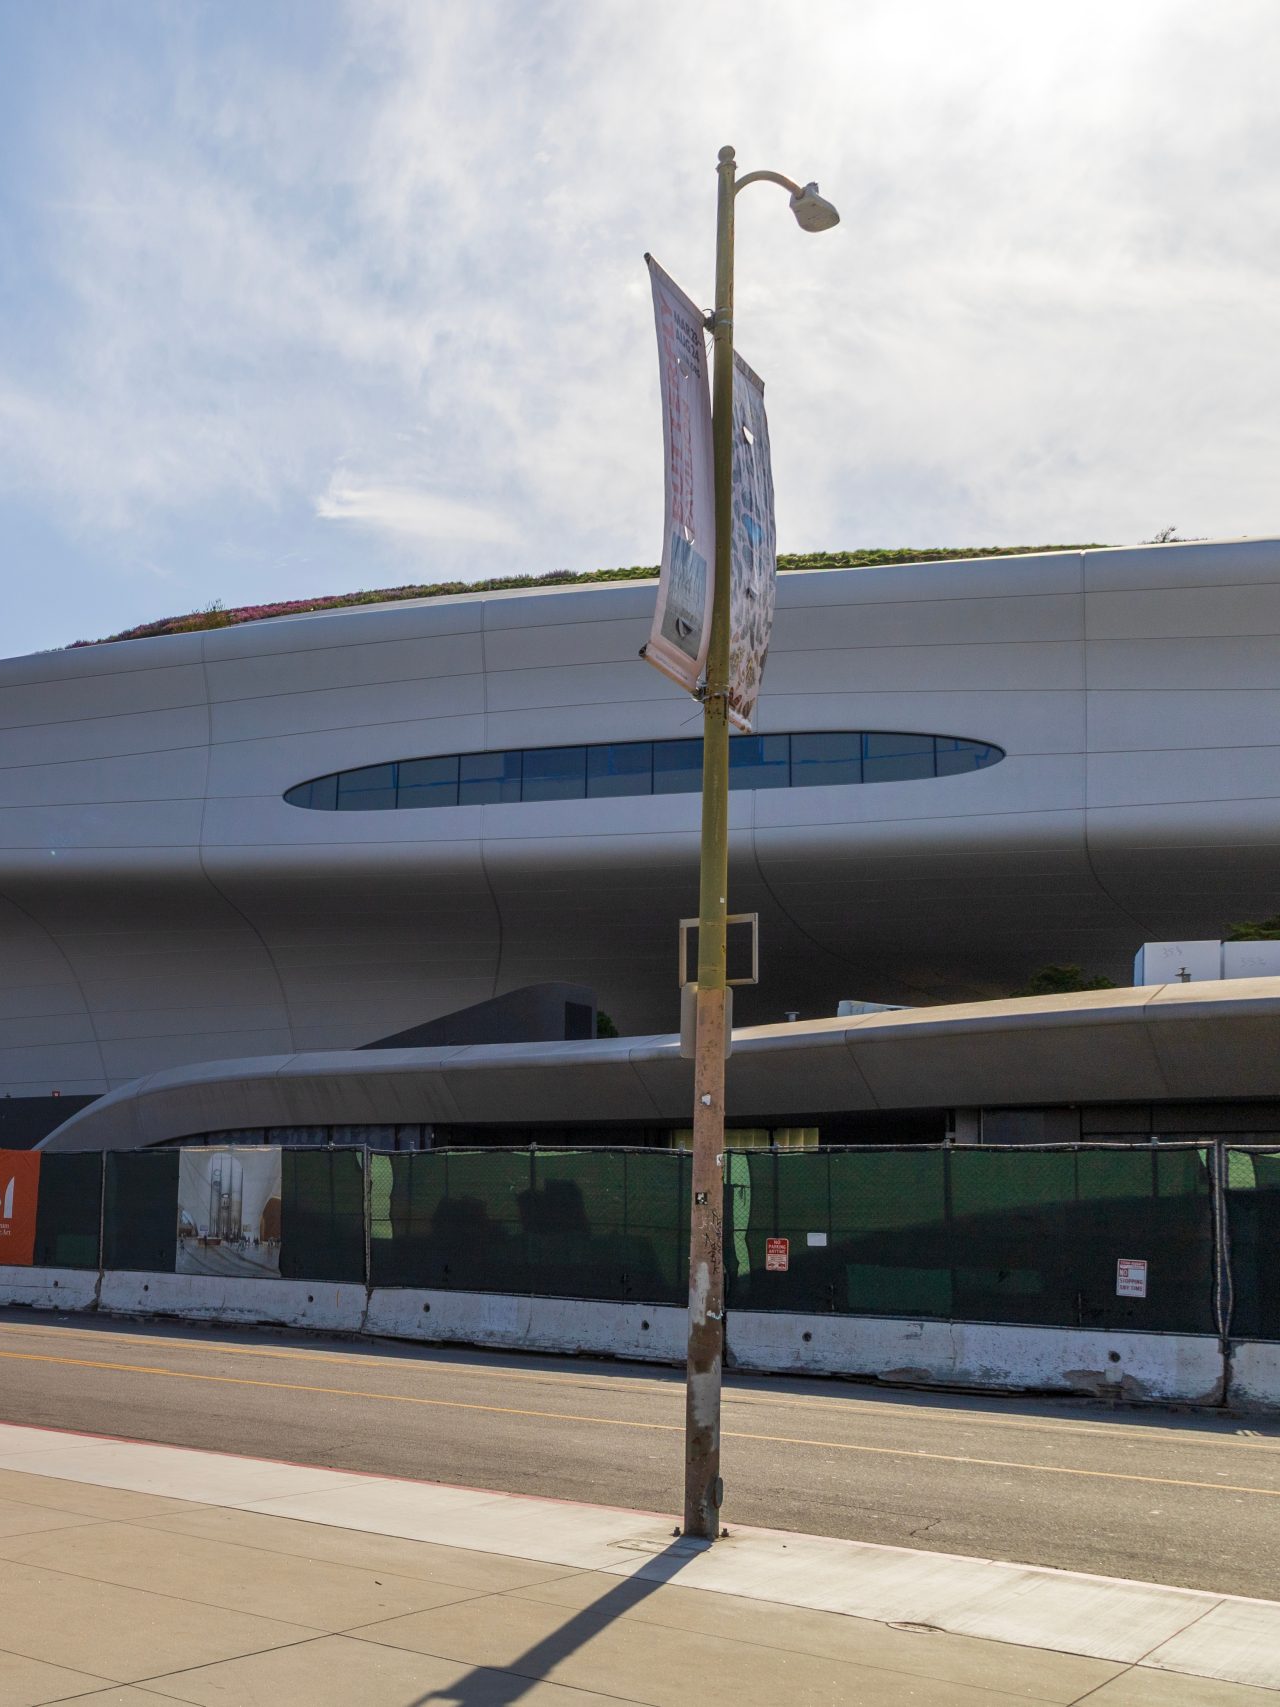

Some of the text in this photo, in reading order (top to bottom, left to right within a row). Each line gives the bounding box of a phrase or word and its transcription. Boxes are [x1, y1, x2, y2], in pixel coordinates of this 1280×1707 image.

[675, 329, 690, 353] AUG
[660, 292, 683, 525] BUTTERFLY
[1119, 1268, 1128, 1277] NO
